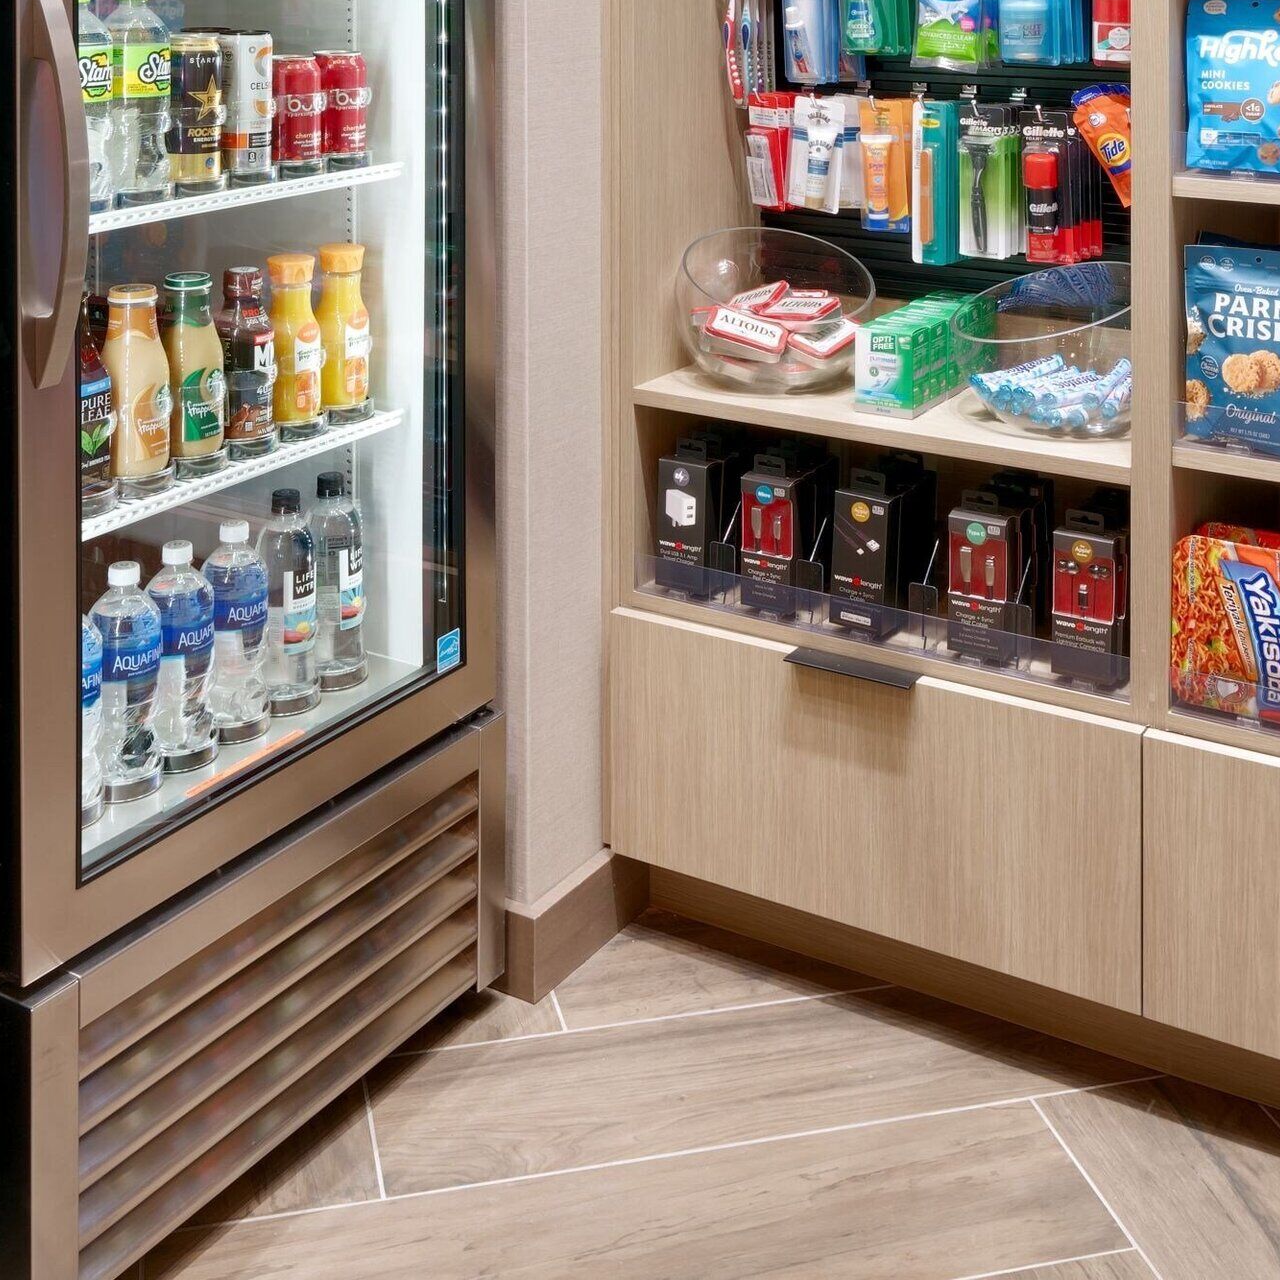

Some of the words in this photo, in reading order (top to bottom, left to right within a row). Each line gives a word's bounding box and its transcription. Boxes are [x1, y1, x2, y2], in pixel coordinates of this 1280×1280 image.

[1201, 70, 1226, 79] MINI
[1201, 81, 1250, 91] COOKIES
[960, 117, 988, 127] Gillette
[1023, 126, 1065, 138] Gillette
[1100, 139, 1126, 162] Tide
[779, 299, 824, 310] ALTOIDS
[720, 314, 777, 340] ALTOIDS
[872, 336, 895, 345] OPTI-
[872, 343, 895, 351] FREE
[81, 393, 111, 413] PURE
[81, 406, 111, 424] LEAF
[1225, 403, 1276, 426] Original
[295, 571, 314, 585] LIFE
